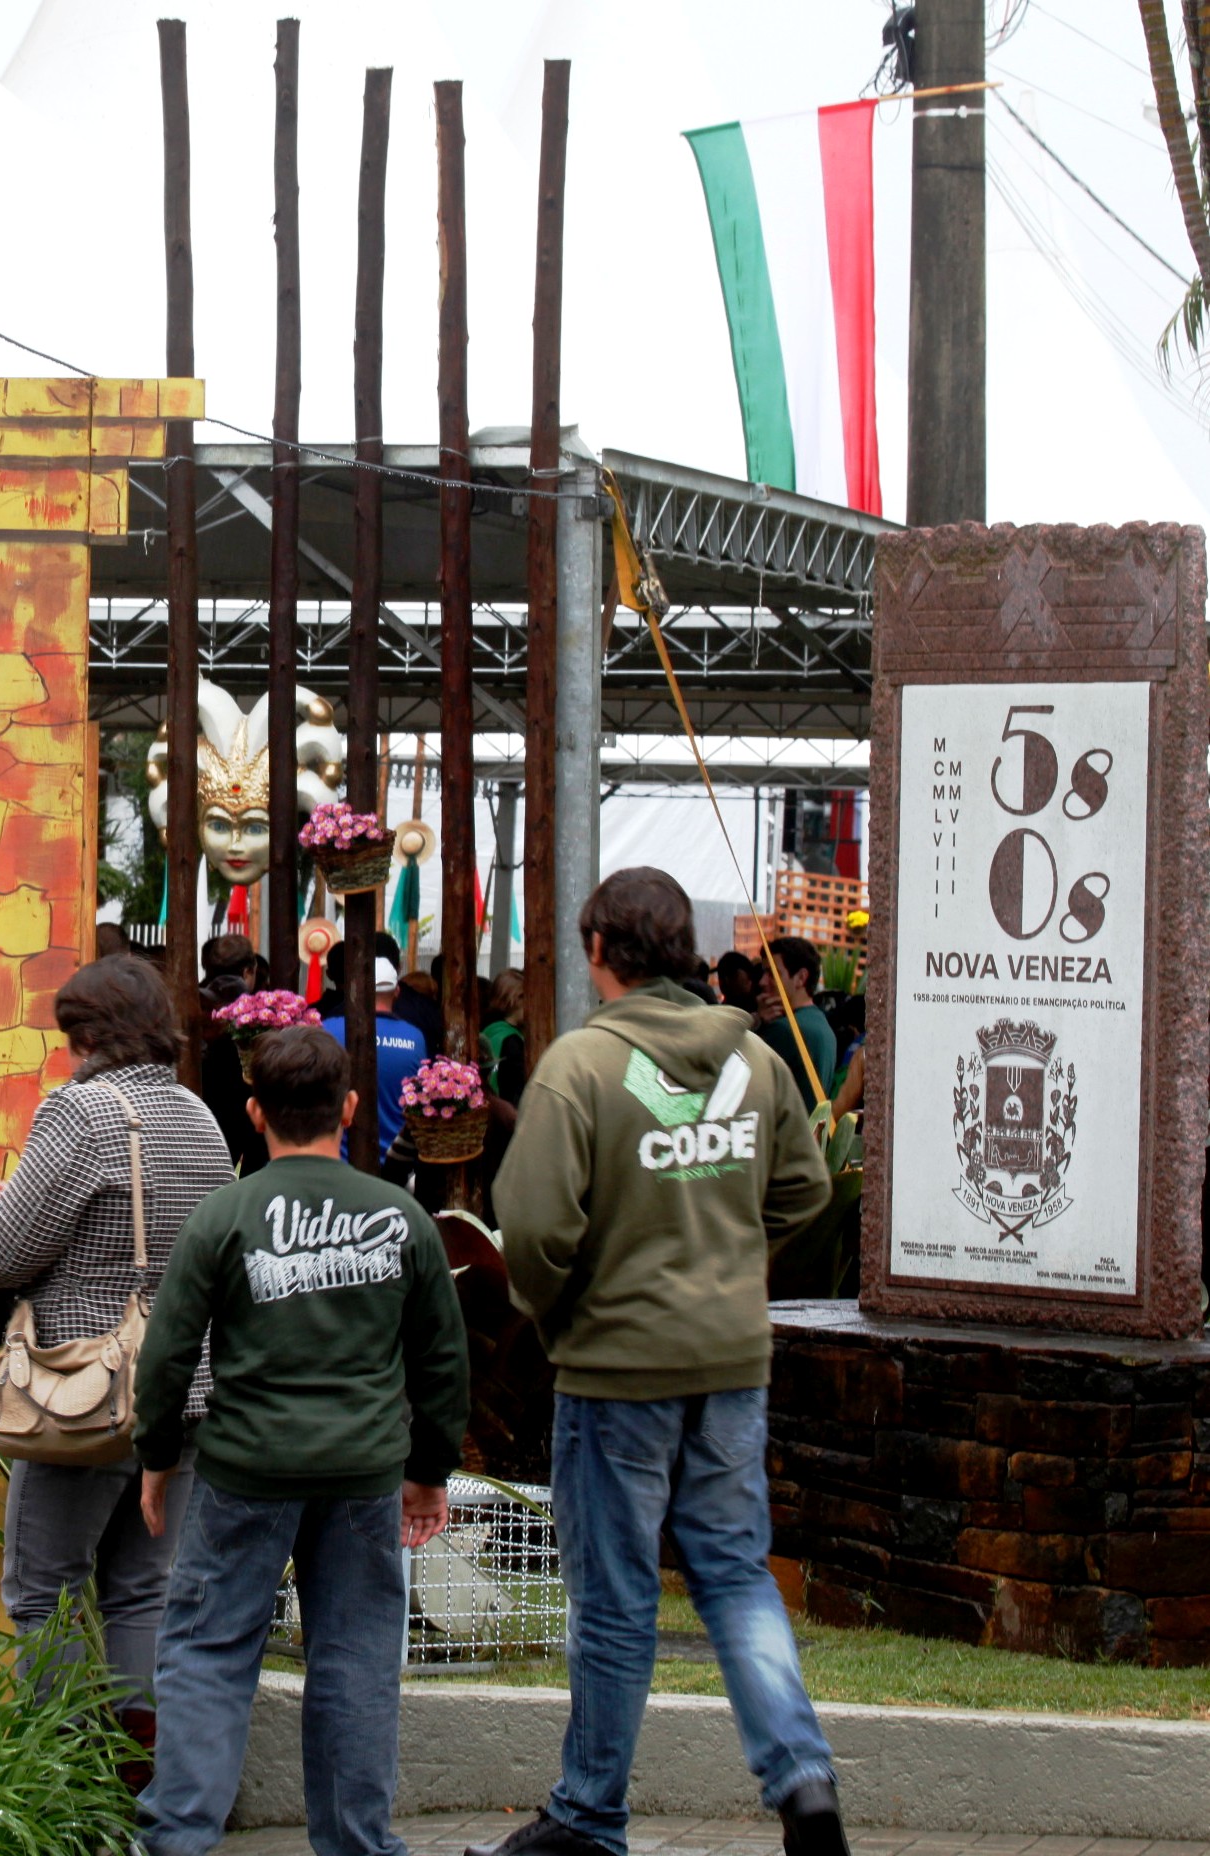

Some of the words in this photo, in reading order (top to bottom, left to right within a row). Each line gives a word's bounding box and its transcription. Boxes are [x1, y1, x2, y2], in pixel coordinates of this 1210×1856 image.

[926, 951, 1000, 980] NOVA
[1007, 954, 1113, 984] VENEZA
[913, 993, 950, 1003] 1958-2008
[1020, 996, 1031, 1006] DE
[1090, 998, 1126, 1011] POLÍTICA
[382, 1036, 415, 1050] AJUDAR?
[638, 1112, 760, 1170] CODE
[962, 1188, 981, 1213] 1891
[984, 1192, 1006, 1212] NOVA
[1007, 1197, 1039, 1213] VENEZA
[1043, 1196, 1064, 1218] 1958
[964, 1246, 987, 1254] MARCOS
